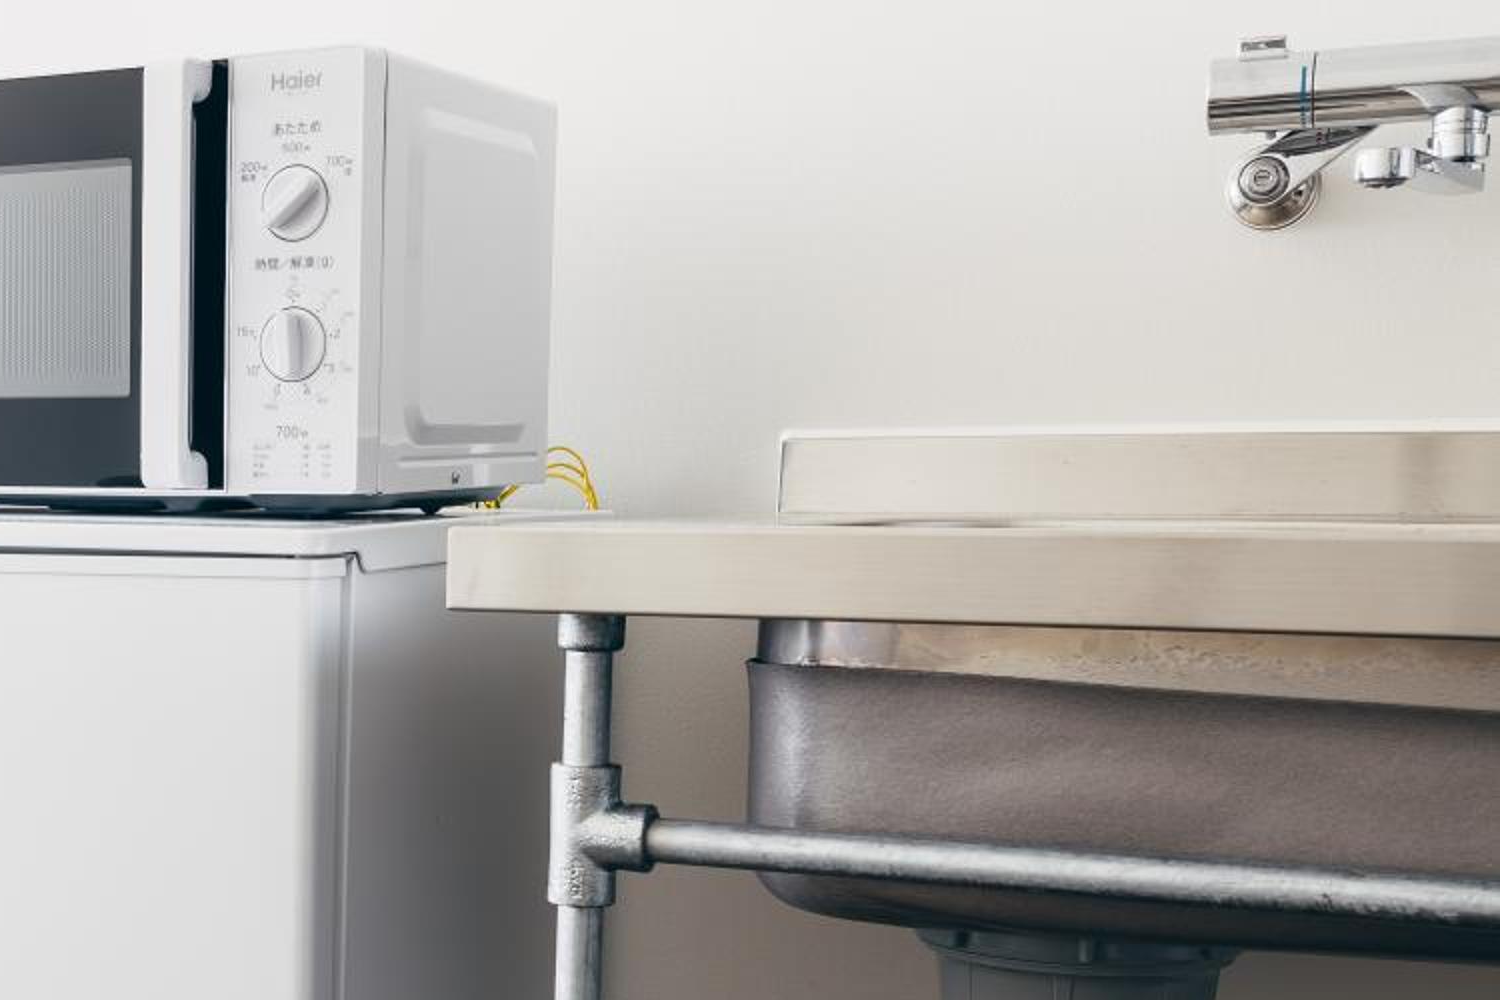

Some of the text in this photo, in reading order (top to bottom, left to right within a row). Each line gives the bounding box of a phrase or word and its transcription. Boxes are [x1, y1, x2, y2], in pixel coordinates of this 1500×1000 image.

[271, 70, 323, 92] Haier
[274, 120, 321, 136] あたため
